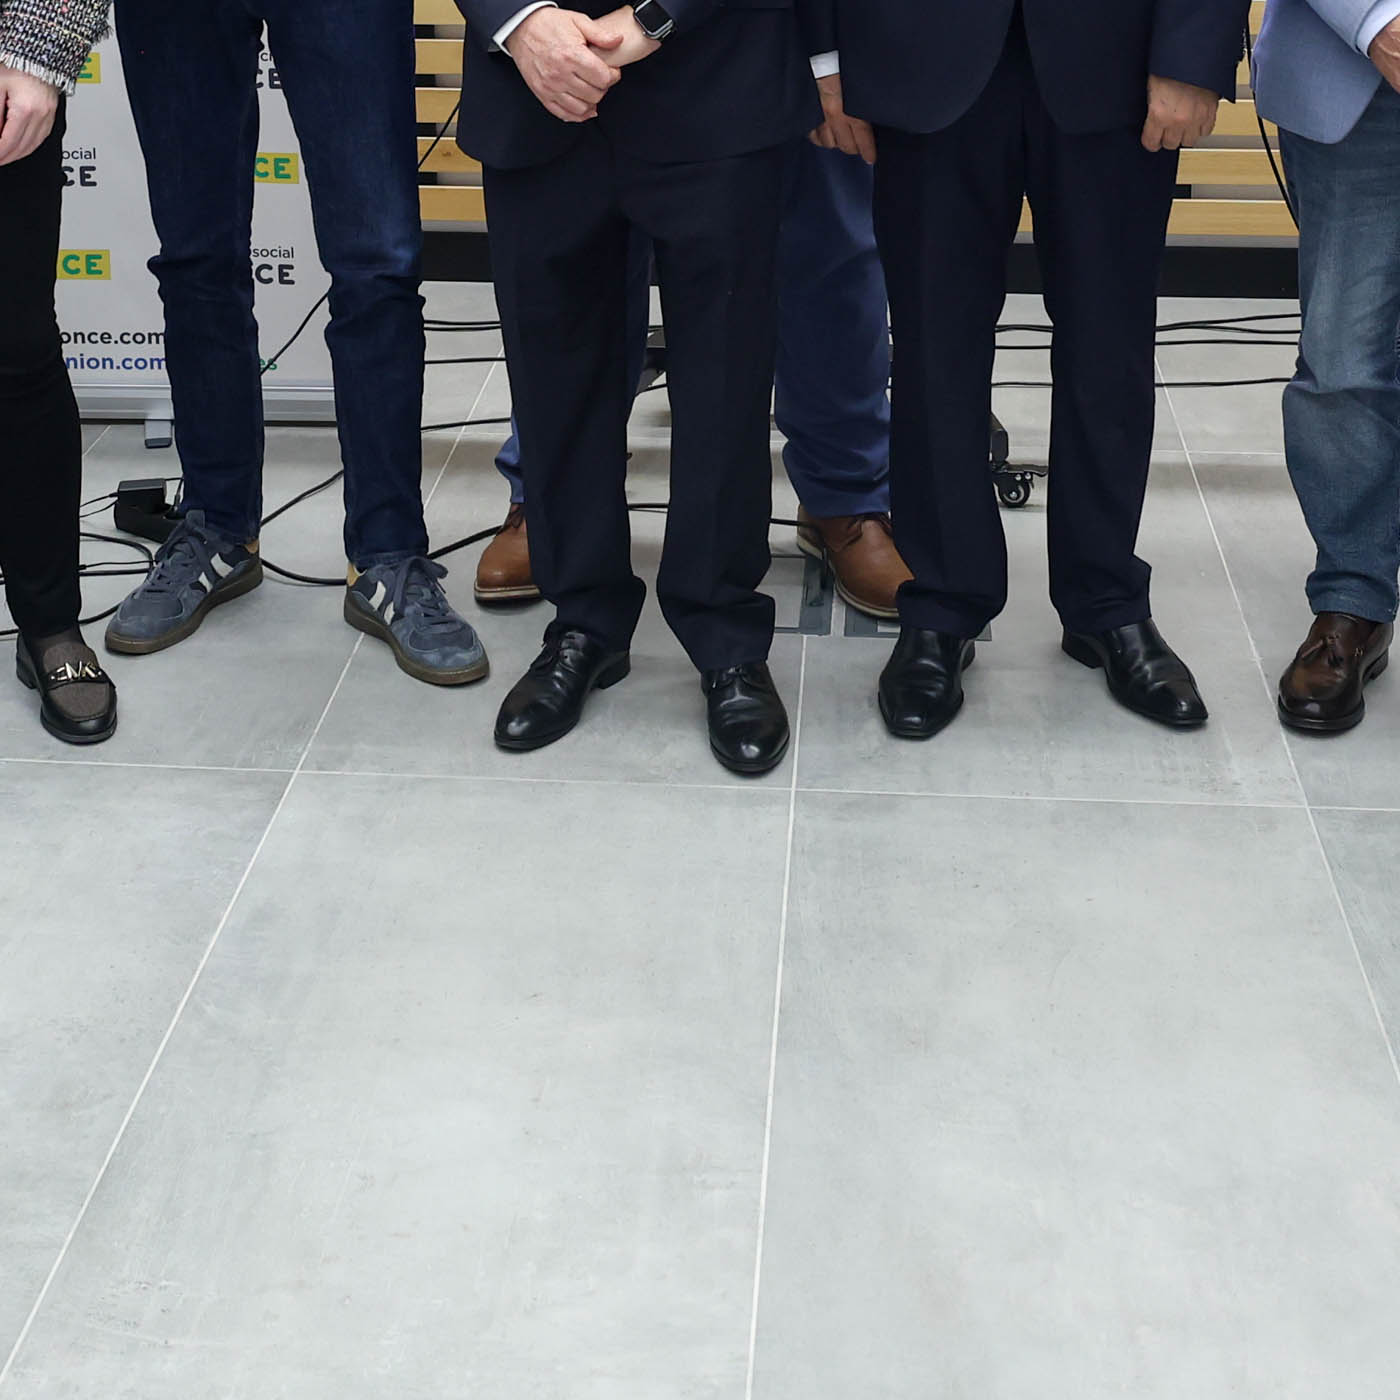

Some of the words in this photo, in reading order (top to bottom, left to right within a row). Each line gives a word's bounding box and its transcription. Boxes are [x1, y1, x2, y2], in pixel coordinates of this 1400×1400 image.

[61, 147, 97, 160] ocial
[254, 157, 292, 180] CE
[251, 244, 295, 260] social
[62, 253, 104, 276] CE
[254, 263, 297, 286] CE
[59, 330, 165, 345] once.com
[64, 352, 168, 370] nion.com
